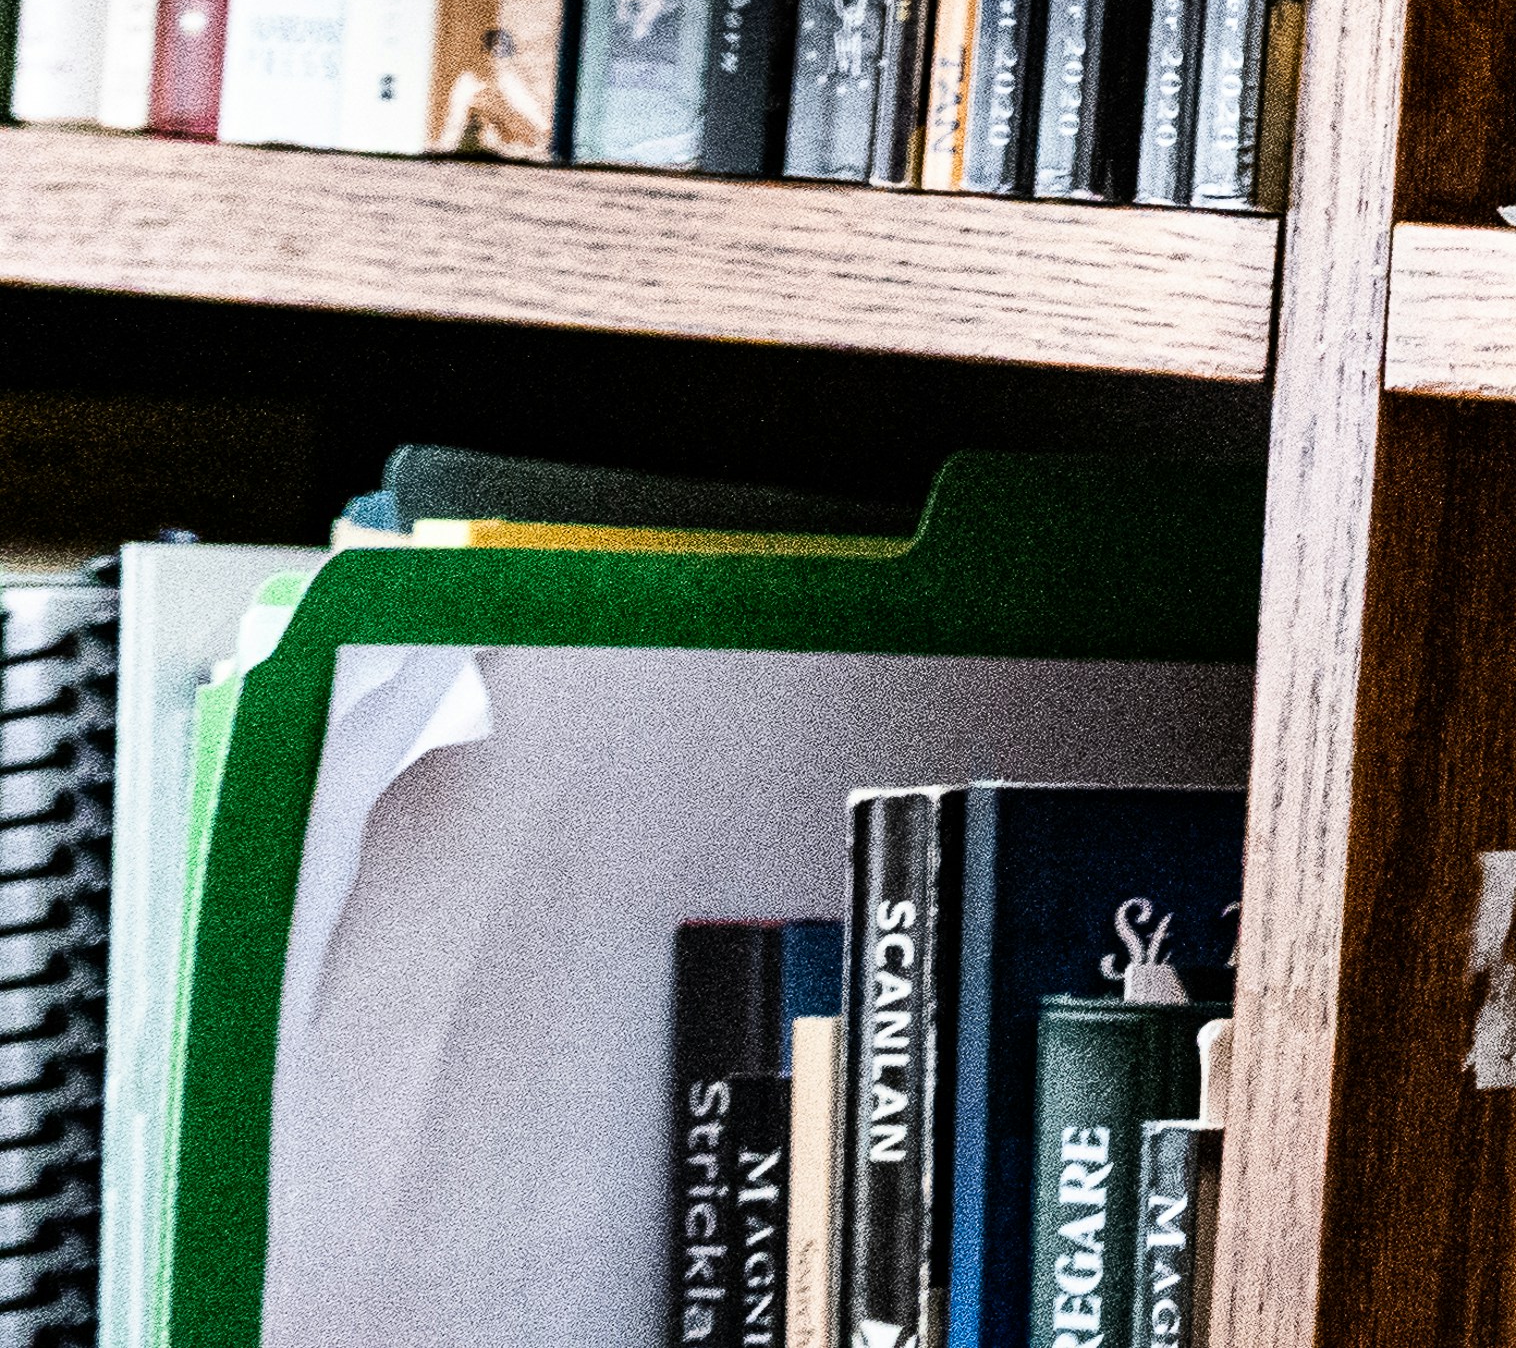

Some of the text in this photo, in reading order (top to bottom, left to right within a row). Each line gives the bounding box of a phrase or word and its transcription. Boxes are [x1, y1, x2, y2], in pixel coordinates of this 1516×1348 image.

[931, 42, 966, 155] TAN
[987, 37, 1020, 148] 2020
[1055, 34, 1089, 140] 2020
[1152, 45, 1184, 148] 2020
[1212, 44, 1242, 151] 2020
[868, 898, 918, 1164] SCANLAN
[681, 1079, 731, 1343] Strickla
[737, 1145, 784, 1345] MAGNI
[1145, 1193, 1189, 1348] MAG
